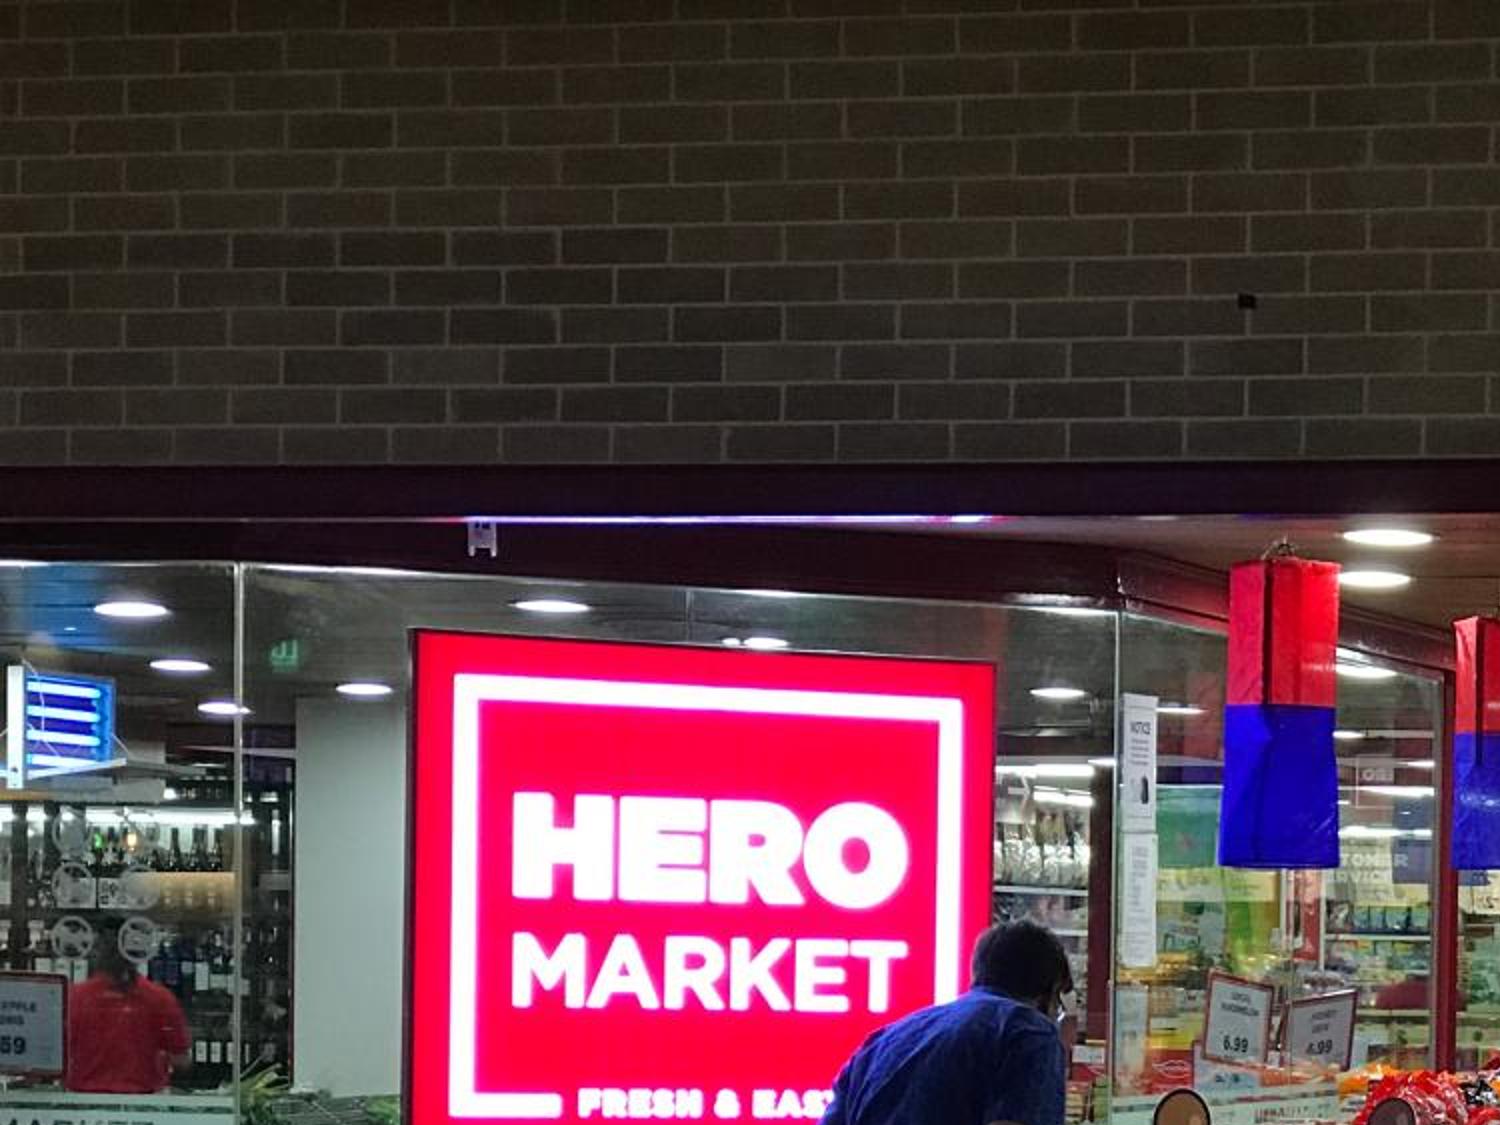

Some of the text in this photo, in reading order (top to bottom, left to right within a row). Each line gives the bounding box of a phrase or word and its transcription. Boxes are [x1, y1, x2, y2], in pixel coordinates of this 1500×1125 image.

[511, 791, 910, 911] HERO
[511, 931, 911, 1014] MARKET
[578, 1088, 703, 1119] FRESH
[714, 1089, 741, 1119] &
